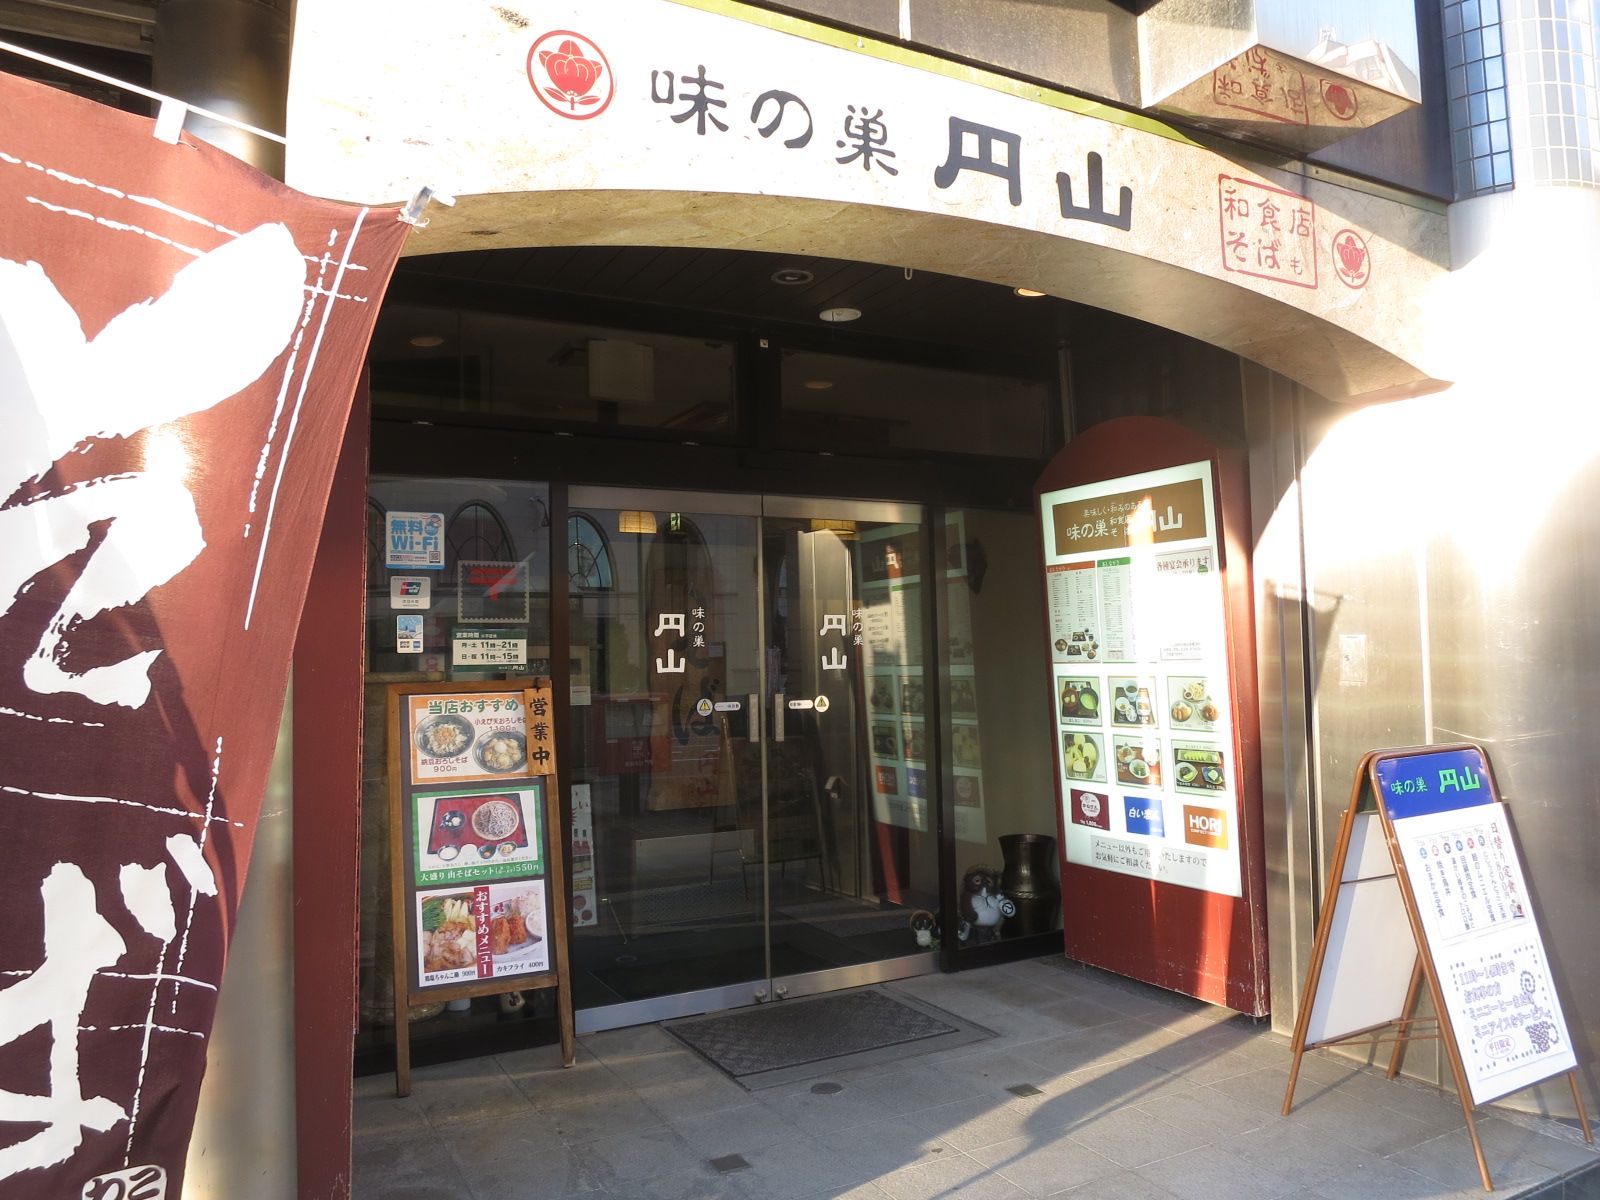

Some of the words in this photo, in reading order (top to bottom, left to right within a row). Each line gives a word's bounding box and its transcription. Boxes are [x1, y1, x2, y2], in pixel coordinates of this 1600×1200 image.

[650, 64, 899, 177] 味の巣
[933, 114, 1133, 231] 円山
[1224, 186, 1311, 238] 和食店
[390, 519, 424, 535] 無料
[391, 534, 439, 551] Wi-Fi
[1066, 519, 1109, 541] 味の巣
[654, 613, 686, 674] 円山
[691, 606, 705, 648] 味の巣
[819, 614, 848, 671] 円山
[851, 608, 864, 647] 味の巣
[428, 699, 519, 715] 当店おすすめ
[529, 698, 551, 766] 営業中
[433, 764, 458, 773] 900円
[1390, 776, 1428, 796] 味の巣
[1438, 766, 1481, 794] 円山
[420, 872, 445, 882] 大盛り
[515, 863, 539, 873] 550円
[475, 890, 491, 976] おすすめメニュー
[496, 963, 525, 973] カキフライ
